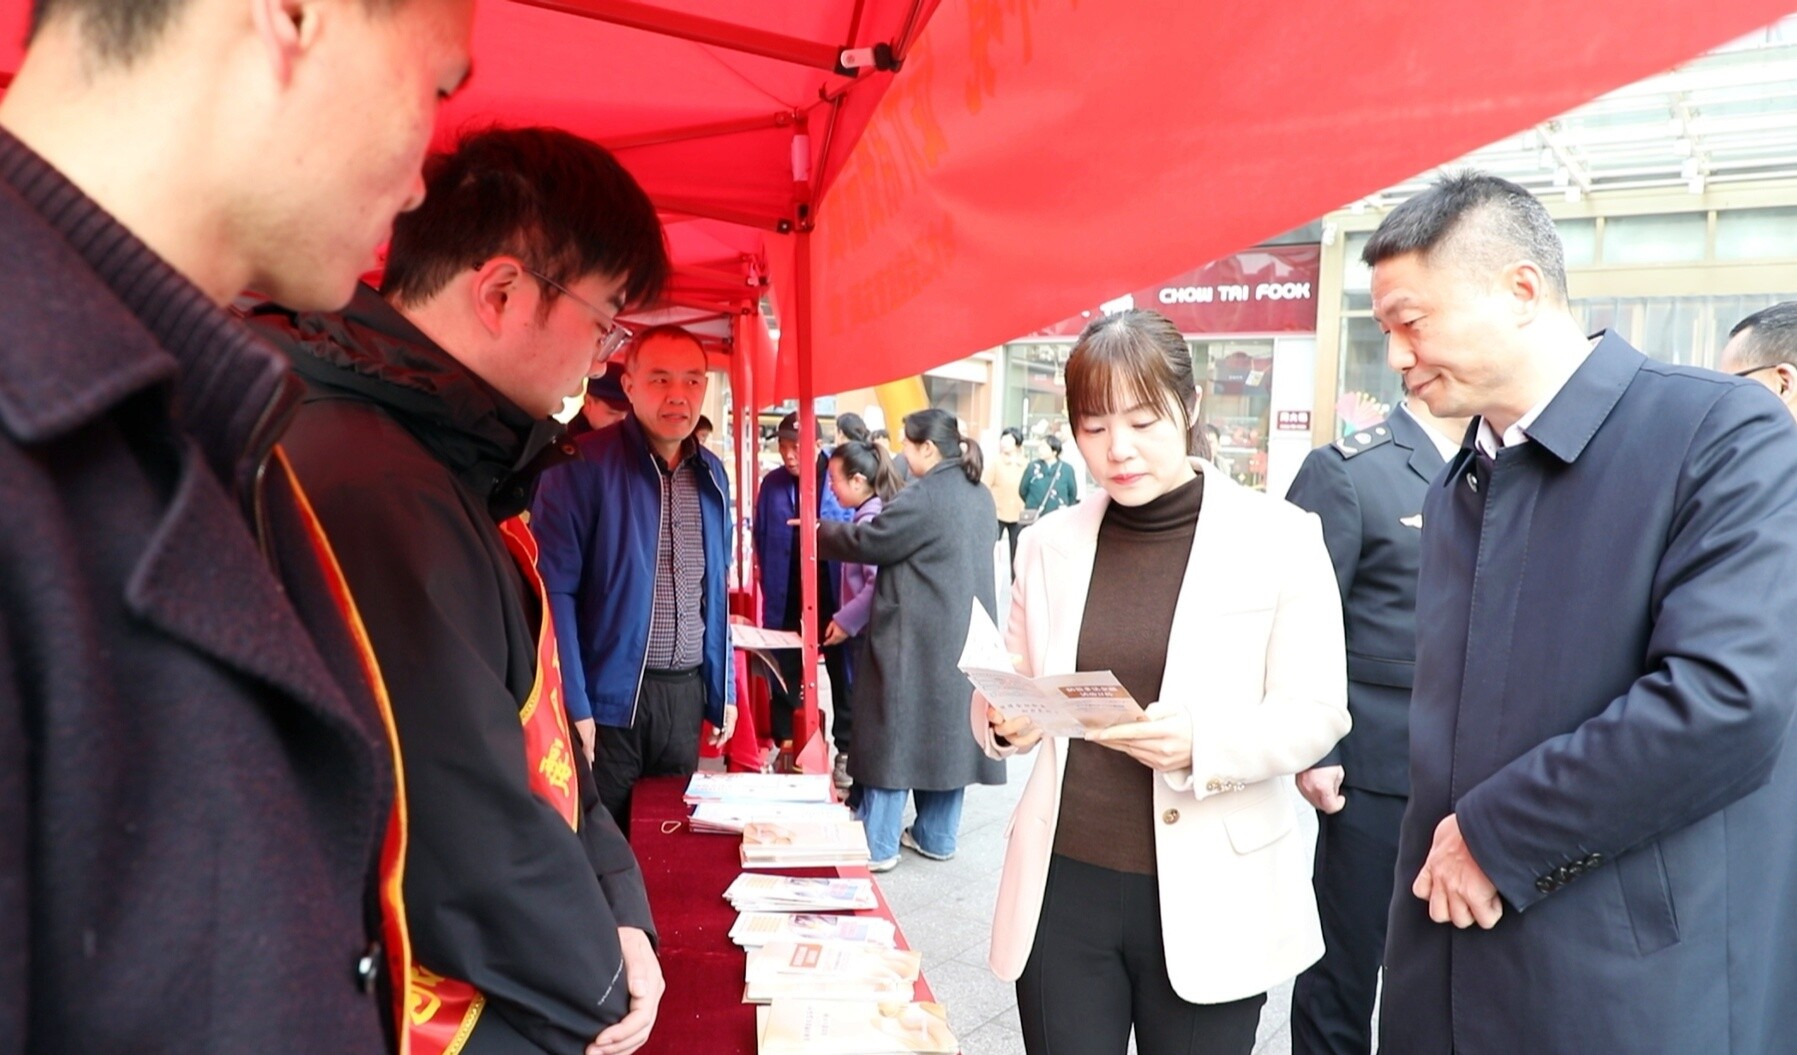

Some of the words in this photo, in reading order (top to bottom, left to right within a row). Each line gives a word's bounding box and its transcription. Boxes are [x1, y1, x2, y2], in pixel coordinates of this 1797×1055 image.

[1159, 287, 1213, 304] CHOW
[1218, 285, 1249, 301] TAI
[1256, 283, 1311, 300] FOOK
